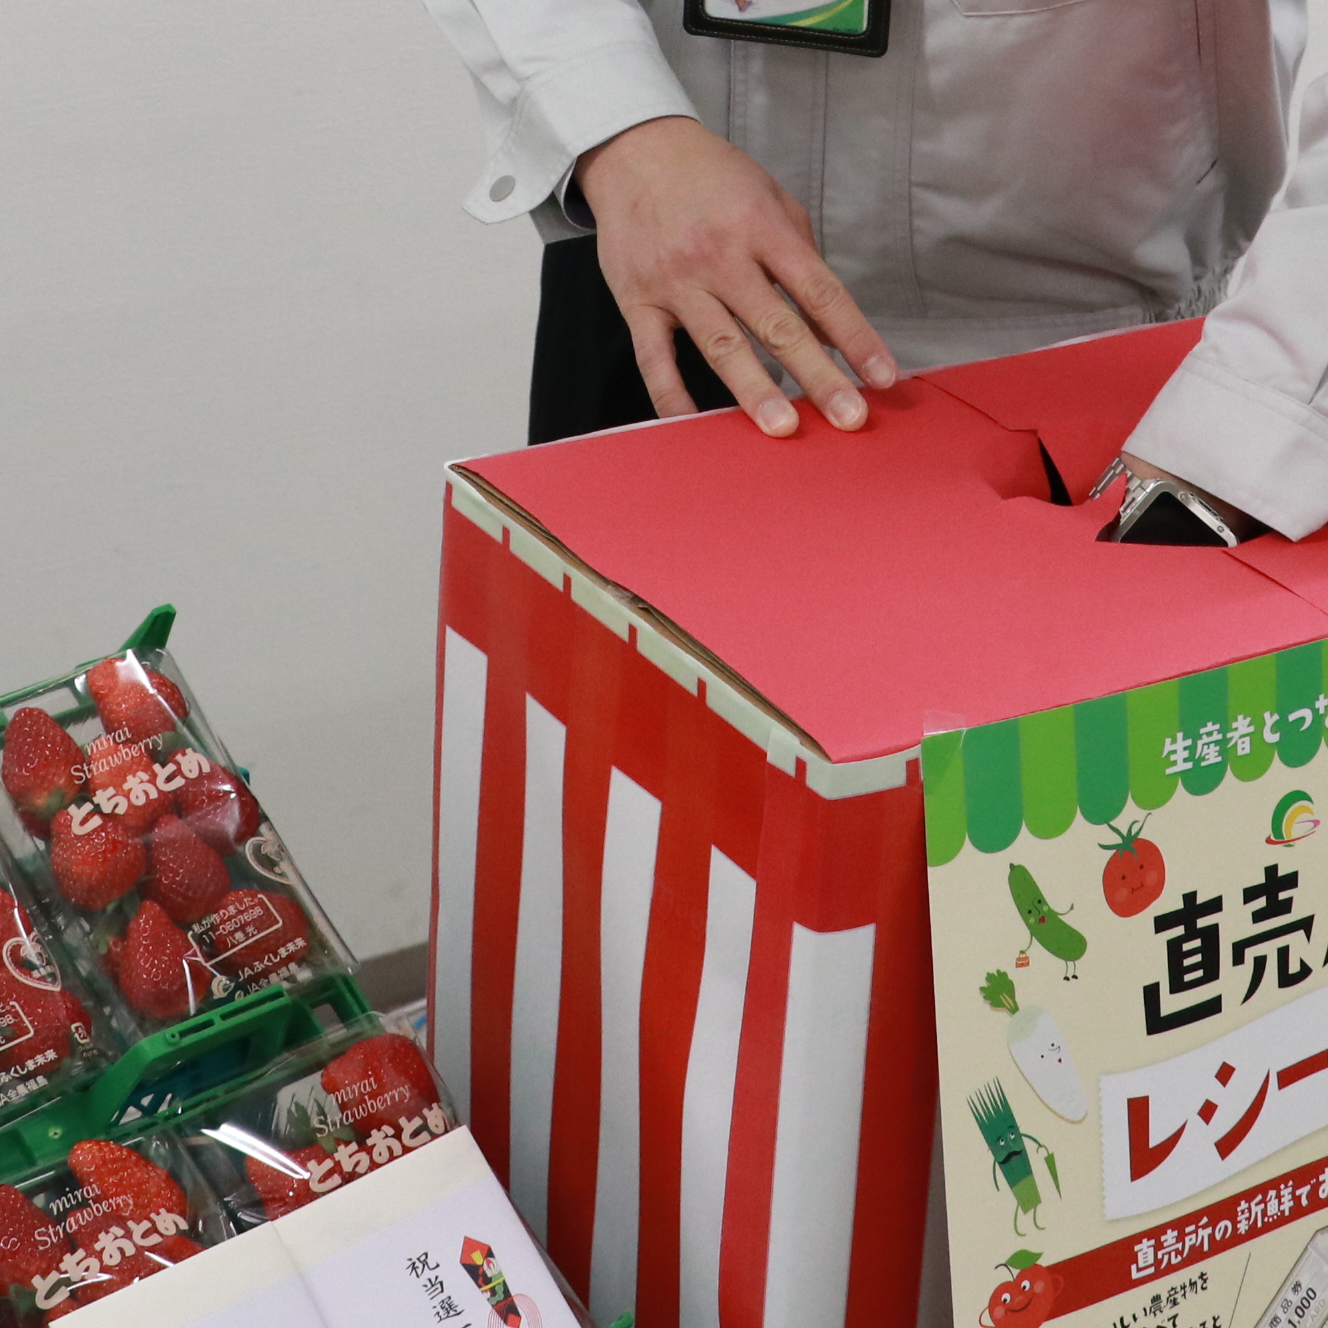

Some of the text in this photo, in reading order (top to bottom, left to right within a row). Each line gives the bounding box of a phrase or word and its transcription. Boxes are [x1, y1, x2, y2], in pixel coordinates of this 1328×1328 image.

[66, 746, 211, 836] とちおとめ
[69, 732, 165, 785] Strawberry
[238, 937, 308, 982] JAふくしま未来
[313, 1081, 412, 1139] Strawberry
[307, 1101, 452, 1194] とちおとめ
[34, 1192, 134, 1251] Strawberry
[31, 1207, 190, 1310] とちおとめ
[405, 1251, 472, 1328] 祝当選
